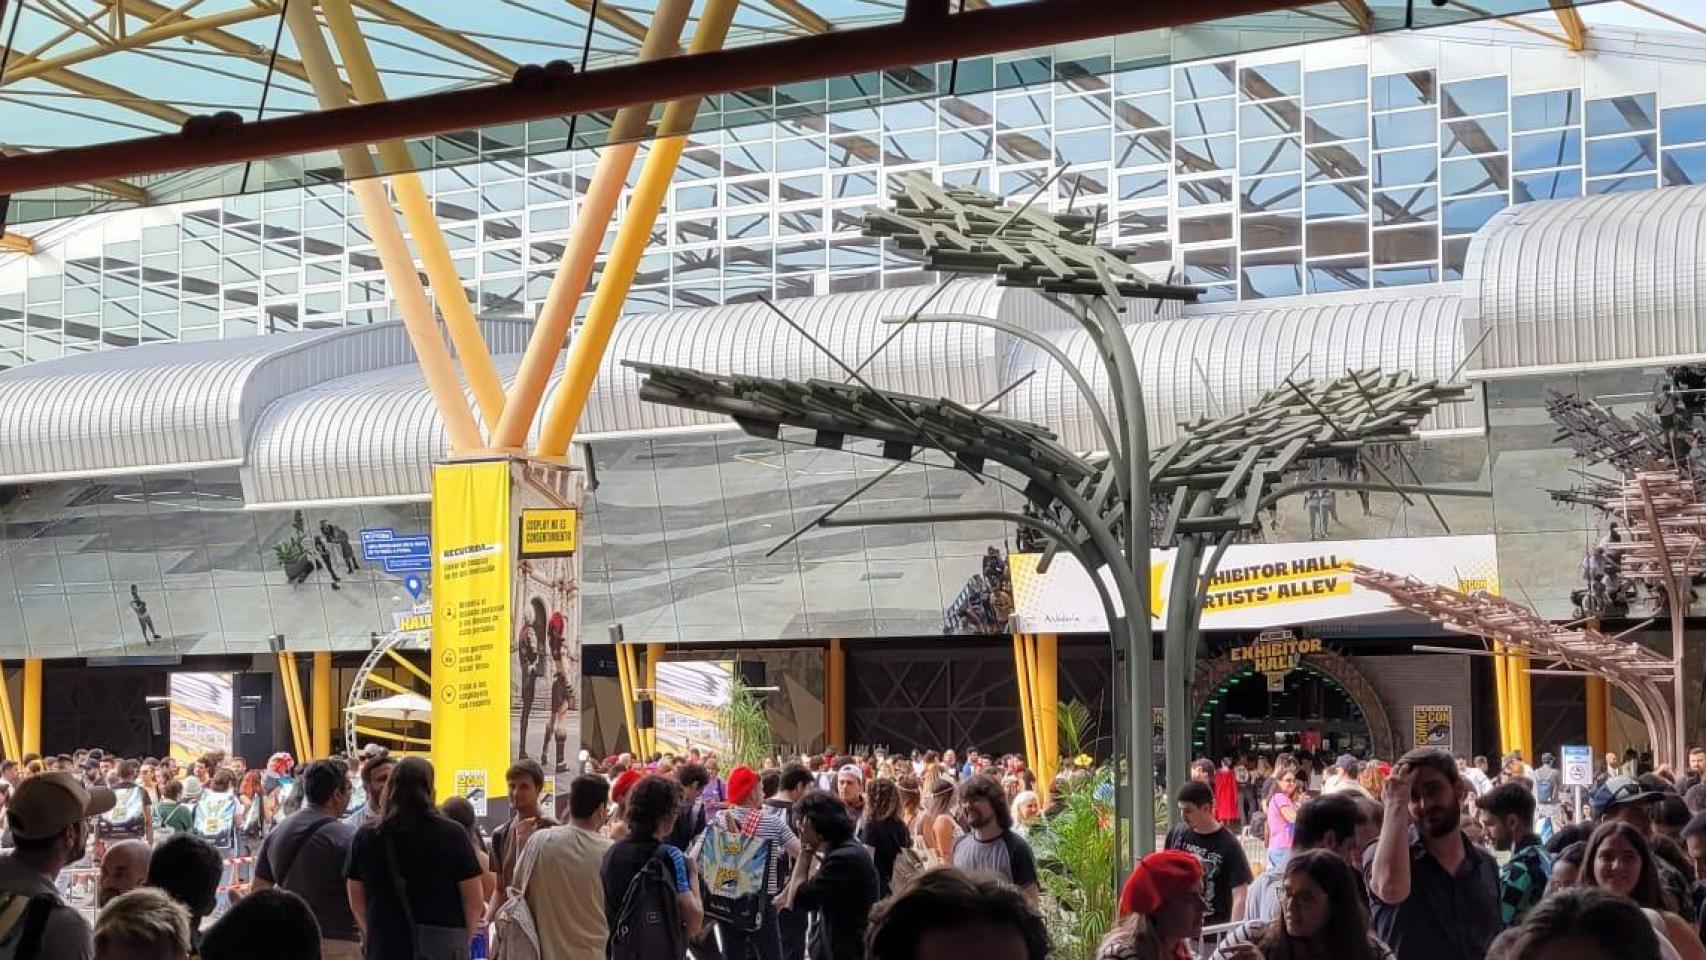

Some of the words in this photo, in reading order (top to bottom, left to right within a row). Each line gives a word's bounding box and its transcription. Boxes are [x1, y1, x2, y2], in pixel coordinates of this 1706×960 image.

[527, 519, 549, 530] COSPLAY
[1208, 560, 1288, 586] HIBITOR
[1292, 555, 1342, 574] HALL
[1202, 585, 1273, 608] RTISTS'
[1277, 577, 1338, 599] ALLEY
[1231, 638, 1323, 661] EXHIBITOR
[1255, 652, 1300, 672] HALL
[1415, 711, 1428, 745] COMIC
[1429, 711, 1451, 723] CON
